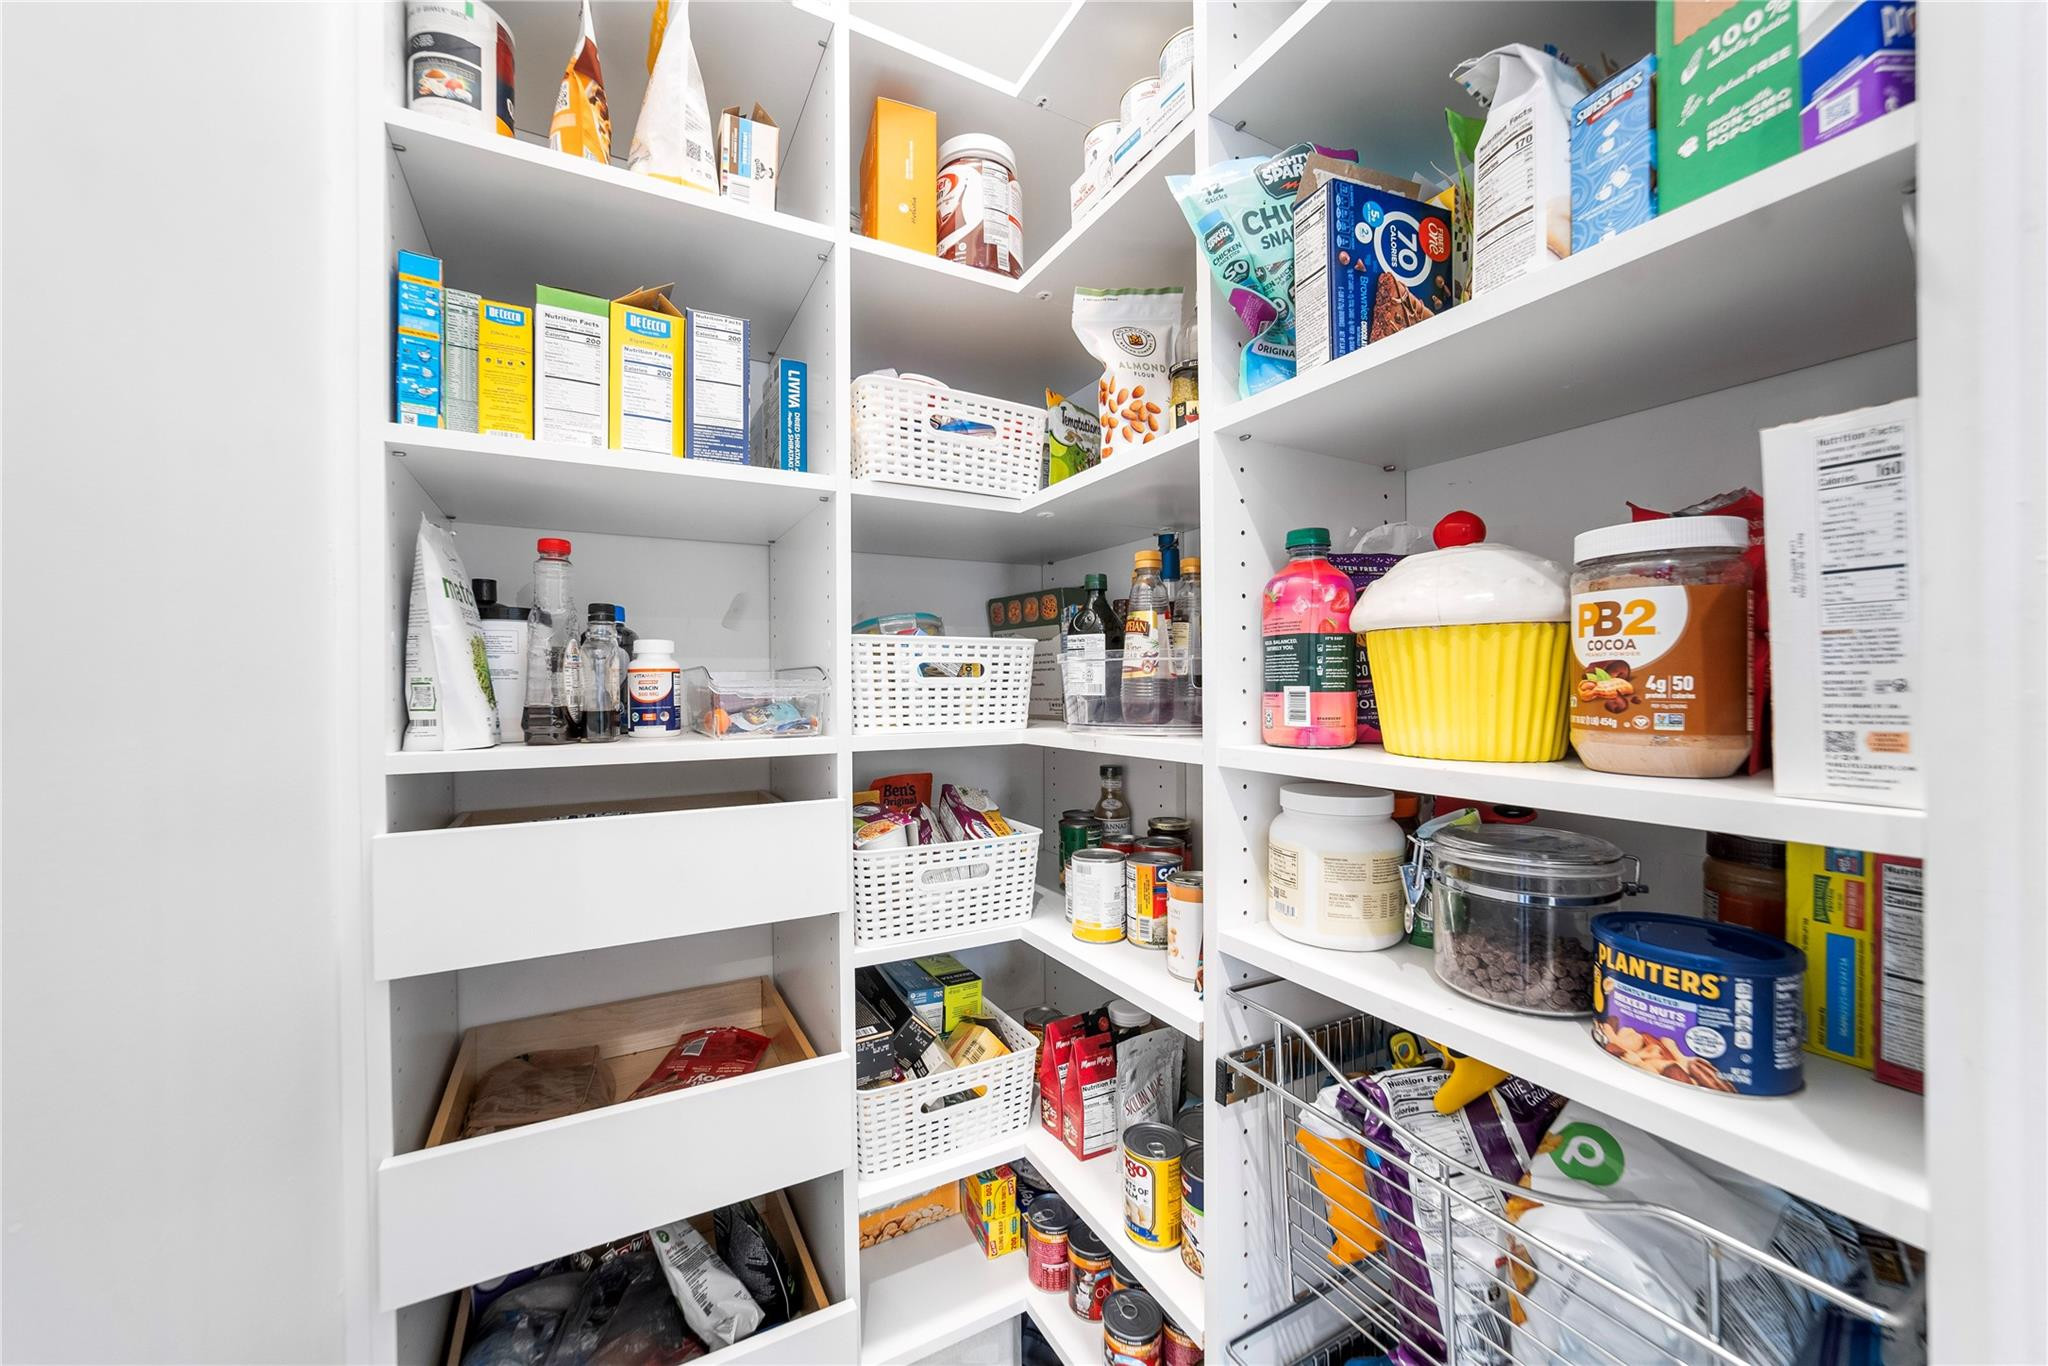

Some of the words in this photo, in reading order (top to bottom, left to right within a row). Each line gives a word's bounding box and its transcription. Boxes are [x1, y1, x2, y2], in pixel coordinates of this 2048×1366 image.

[1707, 0, 1791, 55] 100%
[1746, 44, 1792, 79] FREE
[1576, 93, 1611, 127] SWISS
[1610, 72, 1643, 101] MISS
[1706, 87, 1792, 141] NON-GMO
[1706, 98, 1792, 152] POPCORN
[1515, 134, 1533, 149] 170
[1260, 163, 1304, 186] SPAR
[1205, 193, 1229, 206] Sticks
[1241, 202, 1294, 235] CHI
[1261, 224, 1294, 250] SNA
[1390, 224, 1398, 267] CALORIES
[1213, 241, 1243, 266] CHICKEN
[1398, 230, 1418, 271] 70
[1222, 260, 1249, 281] 50
[1360, 275, 1369, 321] Brownies
[544, 312, 578, 324] Nutrition
[579, 318, 600, 328] Facts
[630, 314, 641, 328] DE
[641, 317, 667, 334] CECCO
[544, 330, 570, 340] Calories
[585, 337, 601, 345] 200
[728, 335, 742, 343] 200
[623, 346, 653, 356] Nutrition
[654, 350, 672, 360] Facts
[1258, 343, 1296, 357] ORIGINA
[623, 365, 648, 374] Calories
[657, 369, 672, 378] 200
[1119, 361, 1166, 373] ALMOND
[788, 369, 801, 409] LIVIVA
[1816, 431, 1866, 447] Nutrition
[1868, 424, 1903, 437] Facts
[1817, 474, 1858, 486] Calories
[1876, 461, 1902, 477] 160
[1334, 564, 1358, 572] LUTEN
[1125, 621, 1148, 632] PEIAN
[1578, 599, 1658, 639] PB2
[1587, 639, 1637, 651] COCOA
[1645, 675, 1667, 692] 4g
[1672, 675, 1694, 691] 50
[883, 782, 916, 798] Ben's
[883, 795, 917, 808] Original
[1884, 865, 1922, 877] Nutriti
[1598, 942, 1721, 1001] PLANTERS
[1613, 991, 1648, 1013] MIXED
[1648, 1004, 1687, 1022] NUTS
[1082, 1080, 1109, 1092] Nutrition
[1387, 1077, 1424, 1089] Nutrition
[1502, 1078, 1527, 1100] THE
[1137, 1187, 1149, 1196] OF
[1010, 1237, 1018, 1250] 200
